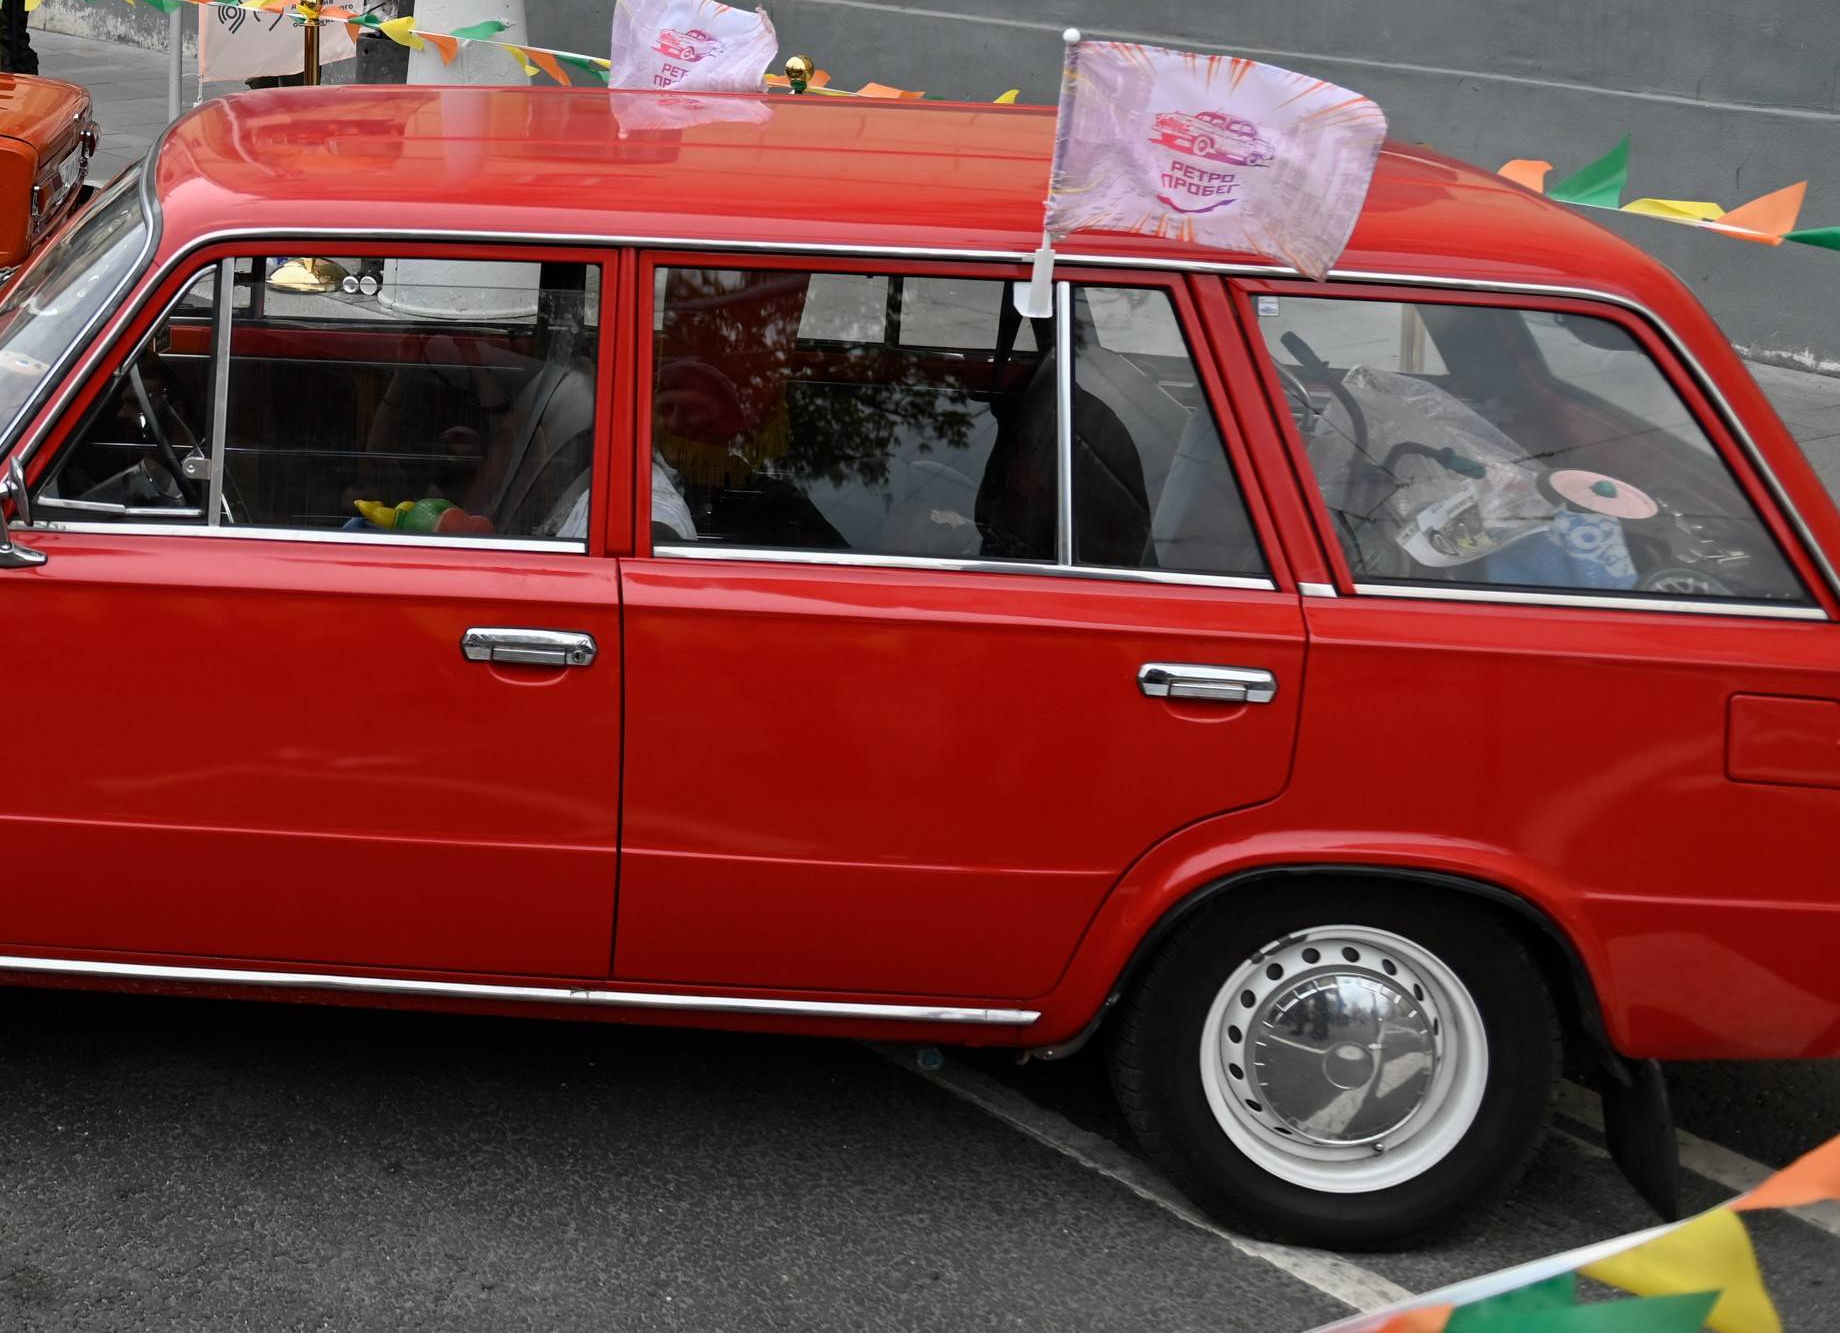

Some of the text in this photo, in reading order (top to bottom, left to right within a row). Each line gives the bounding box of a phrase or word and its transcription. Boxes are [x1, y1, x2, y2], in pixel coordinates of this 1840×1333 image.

[661, 63, 691, 79] РЕТ
[1171, 160, 1236, 184] РЕТРО
[1161, 173, 1241, 197] ПРОБЕГ
